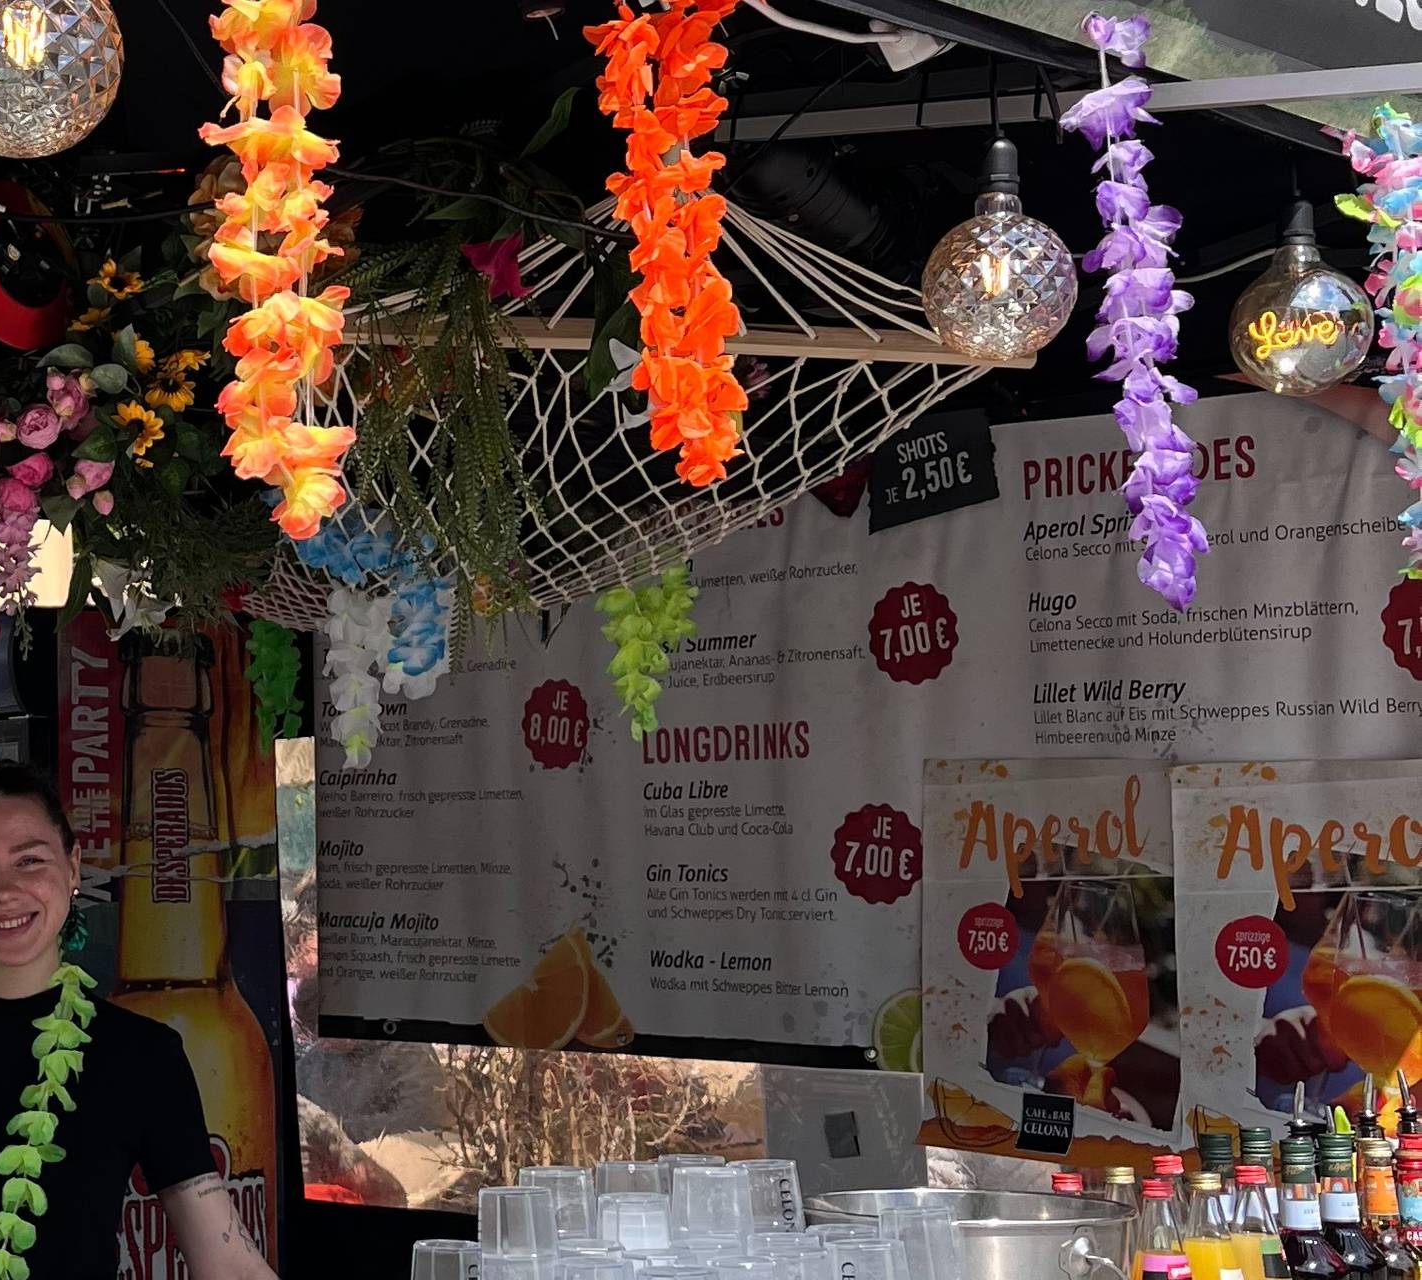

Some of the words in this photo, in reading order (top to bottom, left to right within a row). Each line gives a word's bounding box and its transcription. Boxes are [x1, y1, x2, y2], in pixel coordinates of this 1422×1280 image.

[1248, 311, 1339, 360] Love
[896, 431, 949, 465] SHOTS
[885, 486, 900, 505] JE
[1023, 515, 1085, 544] Aperol
[1025, 543, 1069, 561] Celona
[1073, 541, 1111, 558] Secco
[1114, 539, 1136, 553] mit
[1239, 526, 1269, 544] und
[901, 593, 923, 618] JE
[1028, 592, 1077, 616] Hugo
[1029, 618, 1072, 633] Celona
[1075, 615, 1113, 630] Secco
[1116, 612, 1137, 627] mit
[1142, 609, 1181, 626] Soda,
[1186, 604, 1248, 623] frischen
[1253, 600, 1359, 620] Minzblättern,
[880, 621, 931, 663] 7,00
[1030, 634, 1115, 653] Limettenecke
[1118, 632, 1144, 648] und
[1149, 624, 1313, 647] Holunderblütensirup
[703, 672, 776, 688] Erdbeersirup
[1033, 682, 1077, 704] Lillet
[1083, 679, 1123, 702] Wild
[1129, 679, 1187, 704] Berry
[552, 690, 569, 712] JE
[1034, 710, 1063, 725] Lillet
[1066, 709, 1102, 724] Blanc
[1106, 707, 1126, 723] auf
[1129, 706, 1147, 721] Eis
[1152, 706, 1176, 721] mit
[1180, 703, 1270, 722] Schweppes
[1276, 701, 1335, 717] Russian
[1339, 698, 1379, 715] Wild
[71, 646, 110, 783] PARTY
[642, 720, 811, 765] LONGDRINKS
[1035, 730, 1104, 745] Himbeeren
[1107, 729, 1131, 744] und
[1135, 727, 1177, 743] Minze
[318, 768, 398, 790] Caipirinha
[642, 780, 683, 800] Cuba
[688, 780, 729, 800] Libre
[659, 804, 685, 818] Glas
[687, 804, 742, 821] gepresste
[152, 768, 190, 903] DESPERADOS
[644, 823, 685, 837] Havana
[688, 822, 715, 837] Club
[718, 822, 738, 836] und
[741, 821, 794, 836] Coca-Cola
[872, 816, 892, 840] JE
[958, 774, 1151, 899] Aperol
[319, 840, 365, 860] Mojito
[844, 841, 893, 878] 7,00
[343, 862, 373, 874] frisch
[646, 863, 672, 883] Gin
[678, 863, 729, 884] Tonics
[385, 878, 445, 892] Rohrzucker
[669, 887, 689, 901] Gin
[692, 887, 727, 901] Tonics
[729, 889, 771, 901] werden
[814, 888, 837, 902] Gin
[318, 911, 385, 933] Maracuja
[389, 912, 439, 933] Mojito
[647, 906, 667, 919] und
[671, 906, 734, 922] Schweppes
[737, 906, 756, 922] Dry
[650, 949, 705, 969] Wodka
[720, 951, 772, 972] Lemon
[650, 977, 687, 991] Wodka
[689, 977, 710, 992] mit
[712, 978, 773, 995] Schweppes
[804, 983, 849, 998] Lemon
[1053, 1111, 1071, 1121] BAR
[1023, 1122, 1069, 1139] CELONA
[779, 1178, 796, 1233] CELON
